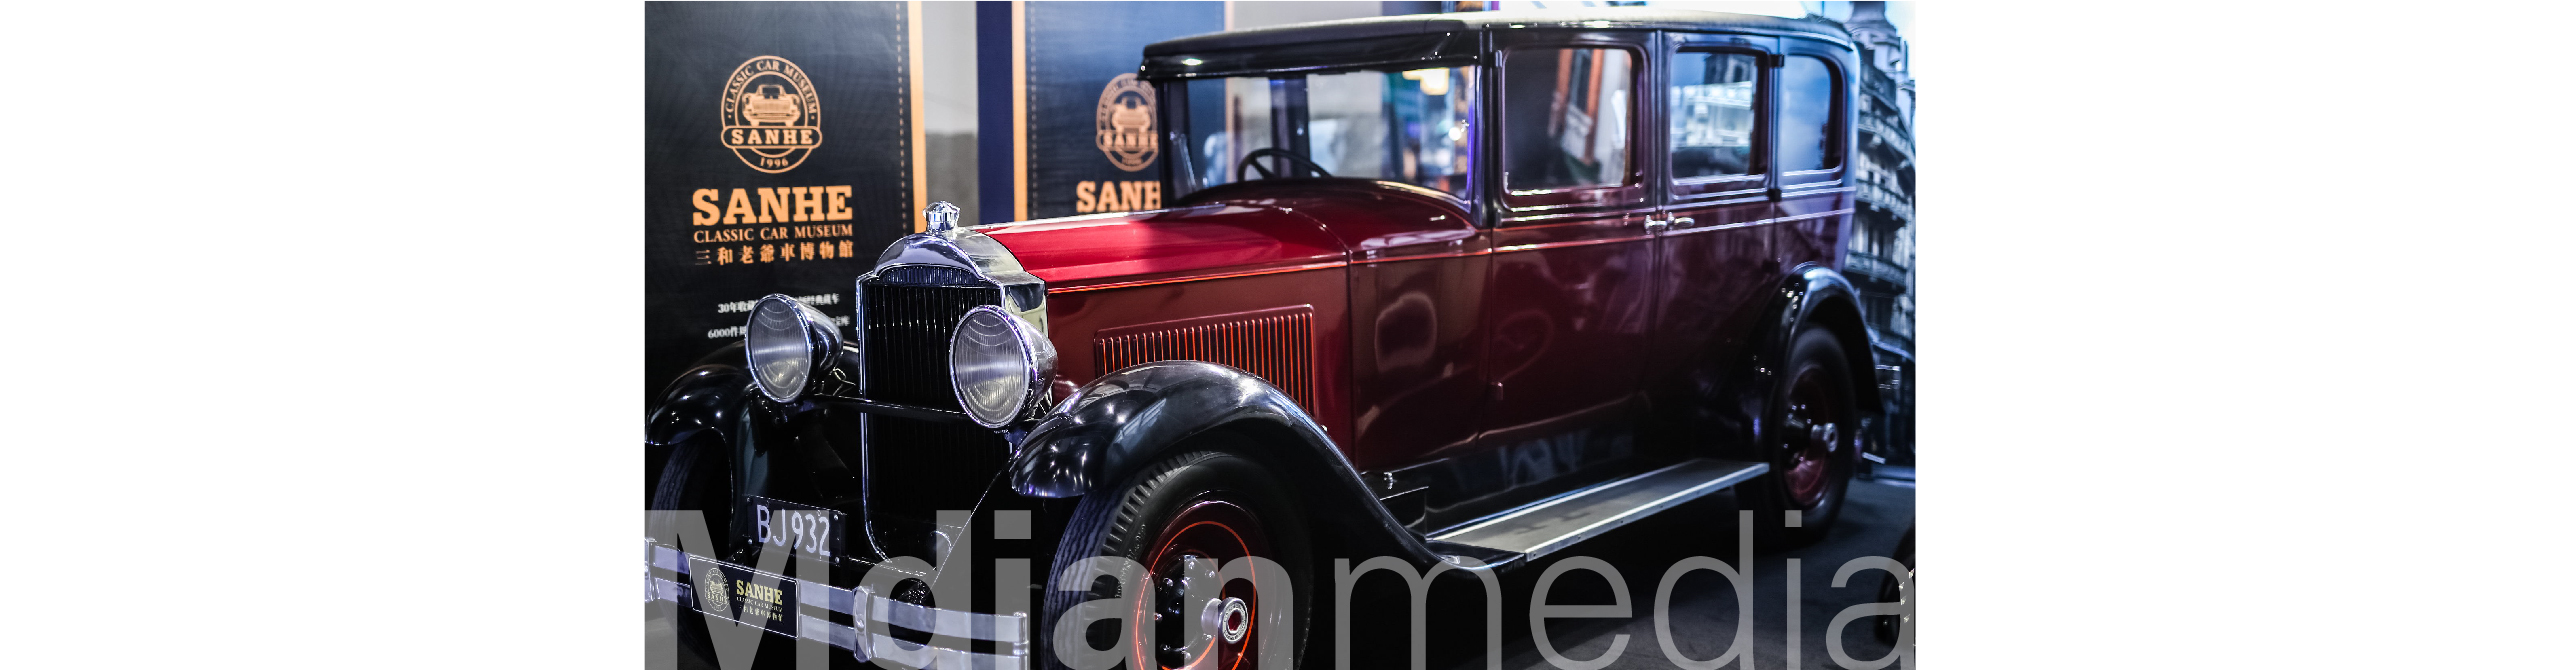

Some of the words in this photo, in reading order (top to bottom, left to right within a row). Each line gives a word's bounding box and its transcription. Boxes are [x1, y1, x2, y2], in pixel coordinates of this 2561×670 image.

[725, 64, 755, 113] CLASSIC
[755, 60, 781, 72] CAR
[783, 63, 817, 114] MUSEUM
[731, 128, 813, 145] SANHE
[760, 156, 789, 168] 1996
[692, 185, 853, 226] SANHE
[1076, 180, 1162, 213] SANH
[693, 228, 755, 243] CLASSIC
[760, 226, 788, 240] CAR
[794, 224, 853, 238] MUSEUM
[694, 240, 854, 266] 三和老爺車博物館
[756, 504, 831, 557] BJ932
[736, 579, 783, 606] SANHE
